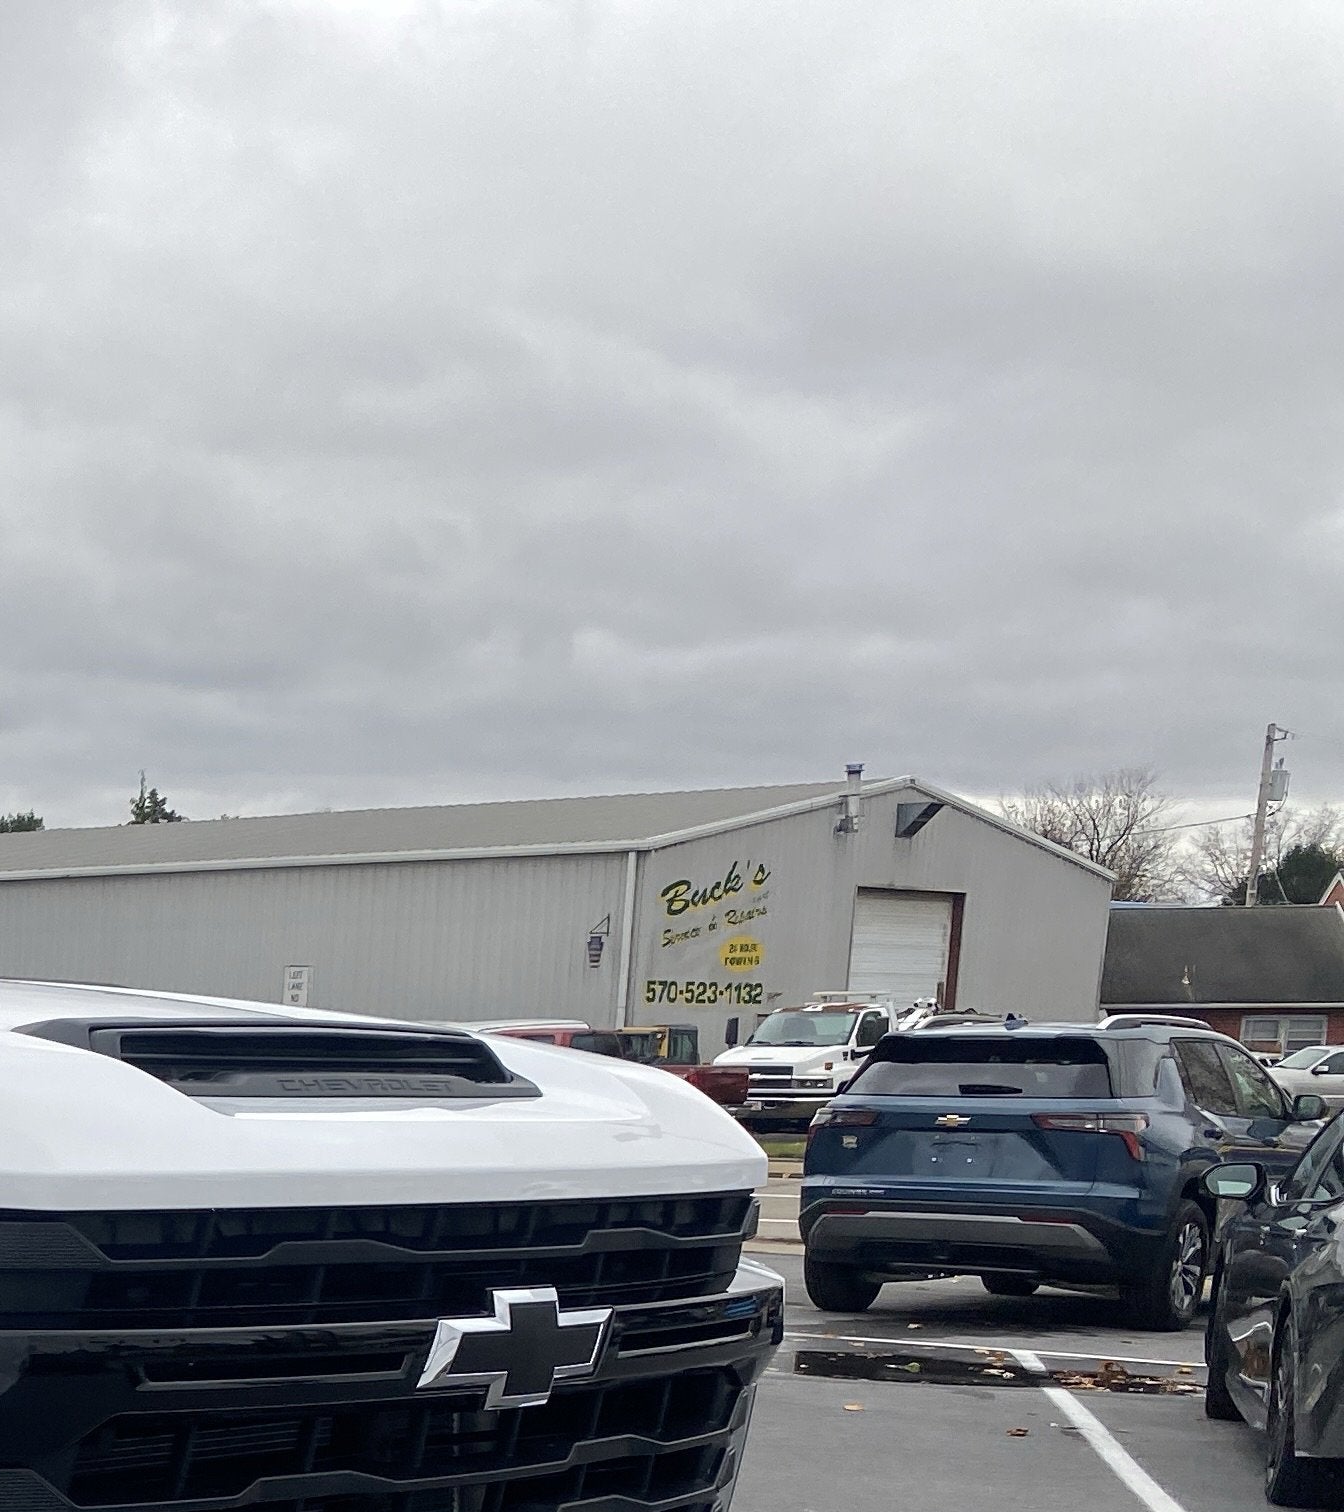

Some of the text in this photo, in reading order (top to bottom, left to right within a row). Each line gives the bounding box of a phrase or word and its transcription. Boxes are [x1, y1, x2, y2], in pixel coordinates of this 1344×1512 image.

[661, 860, 771, 916] Buck's
[645, 980, 763, 1005] 570-523-1132
[276, 1078, 452, 1093] CHEVROLET
